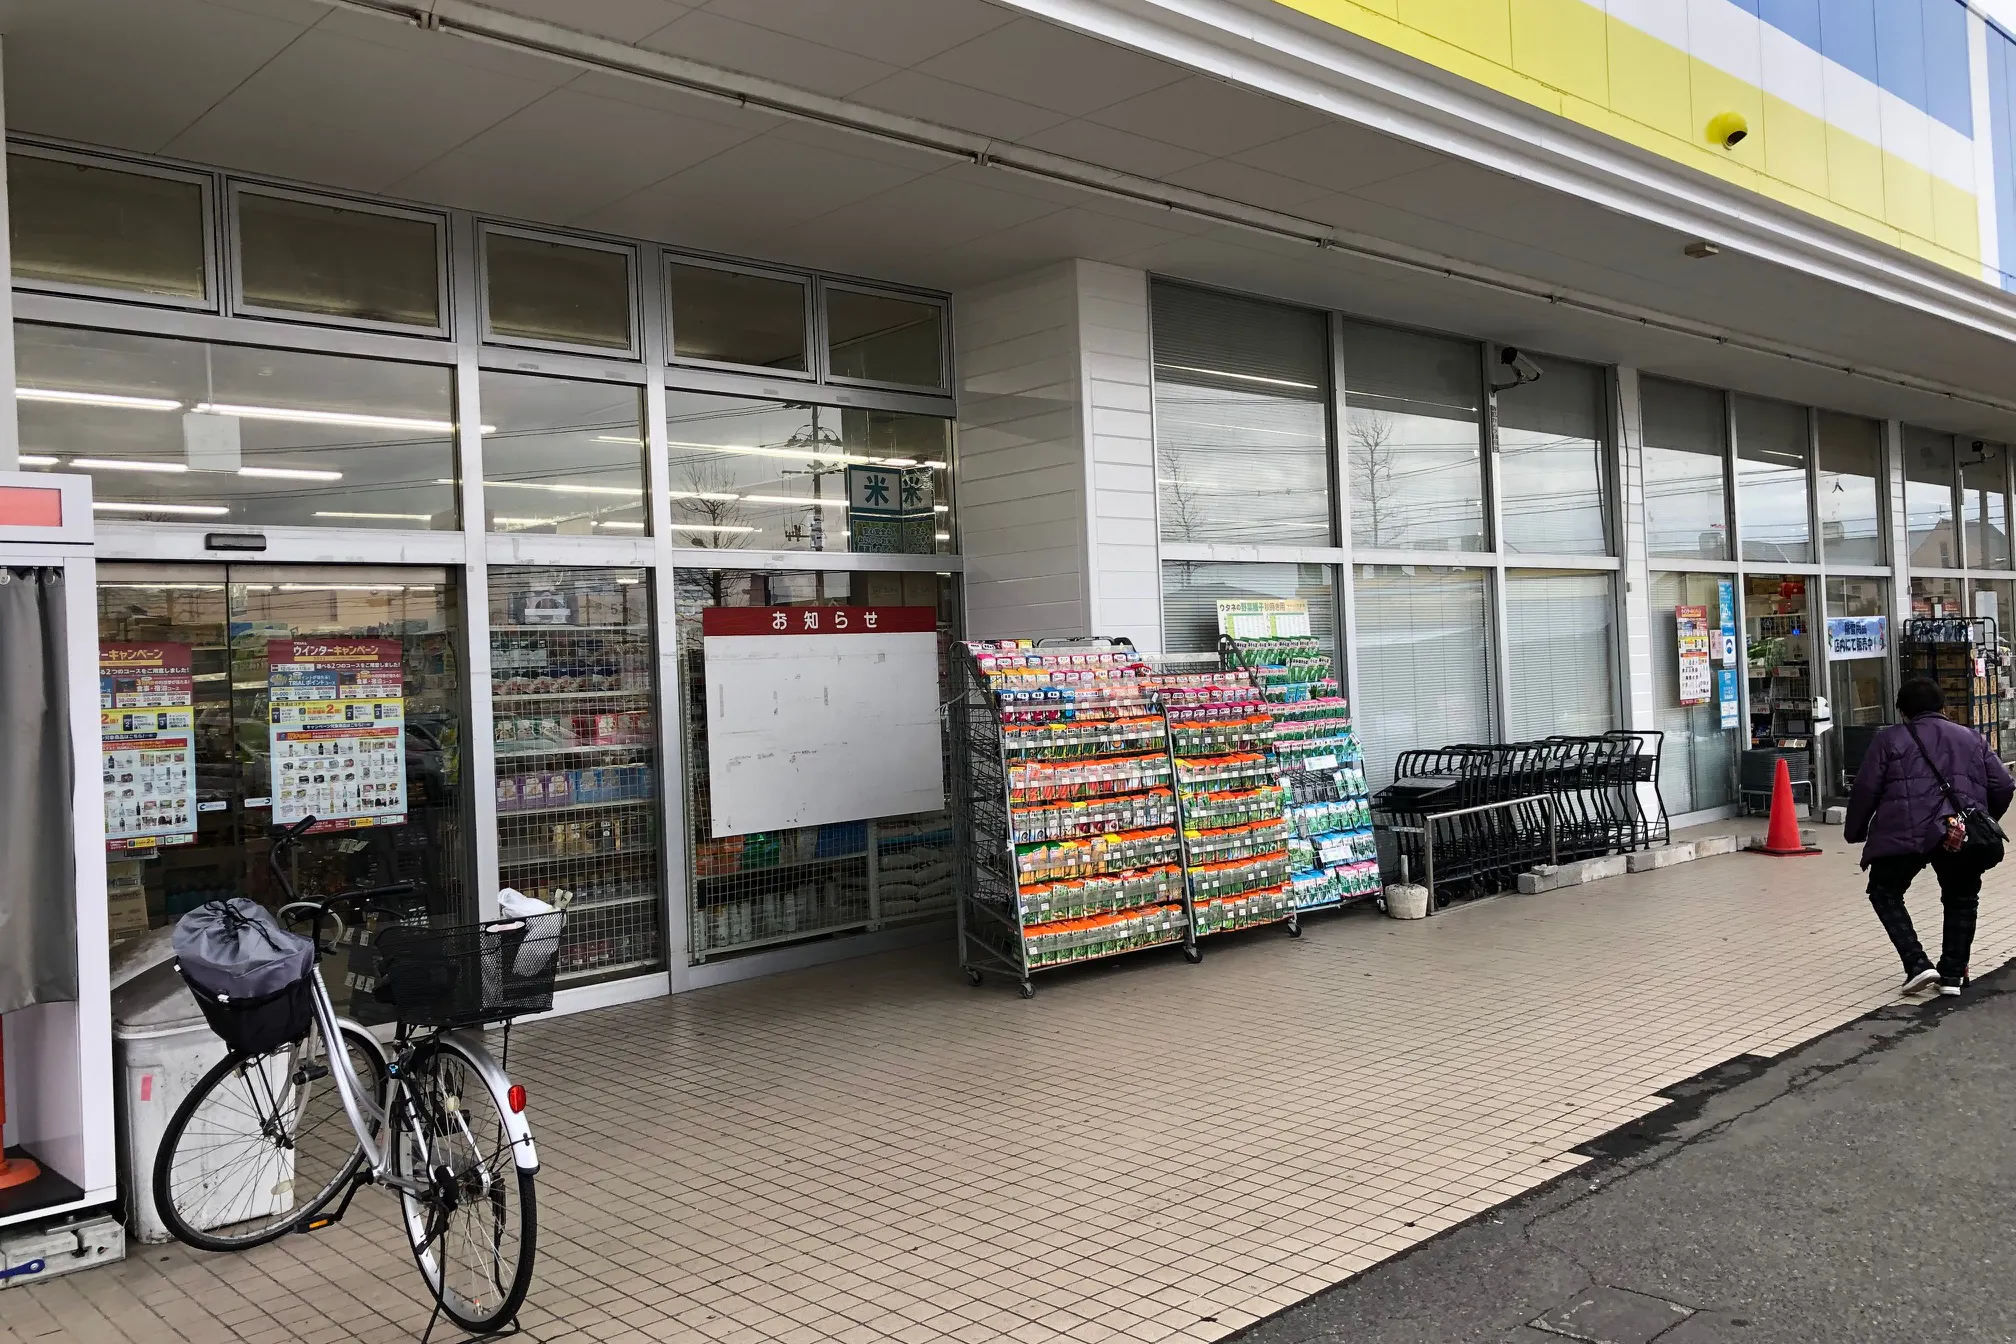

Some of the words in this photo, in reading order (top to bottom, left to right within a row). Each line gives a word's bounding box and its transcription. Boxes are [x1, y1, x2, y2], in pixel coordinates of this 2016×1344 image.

[864, 475, 889, 506] 米
[903, 477, 923, 506] 米
[772, 611, 878, 630] お知らせ
[99, 650, 163, 660] ーキャンペーン
[294, 646, 378, 655] ウインターキャンペーン
